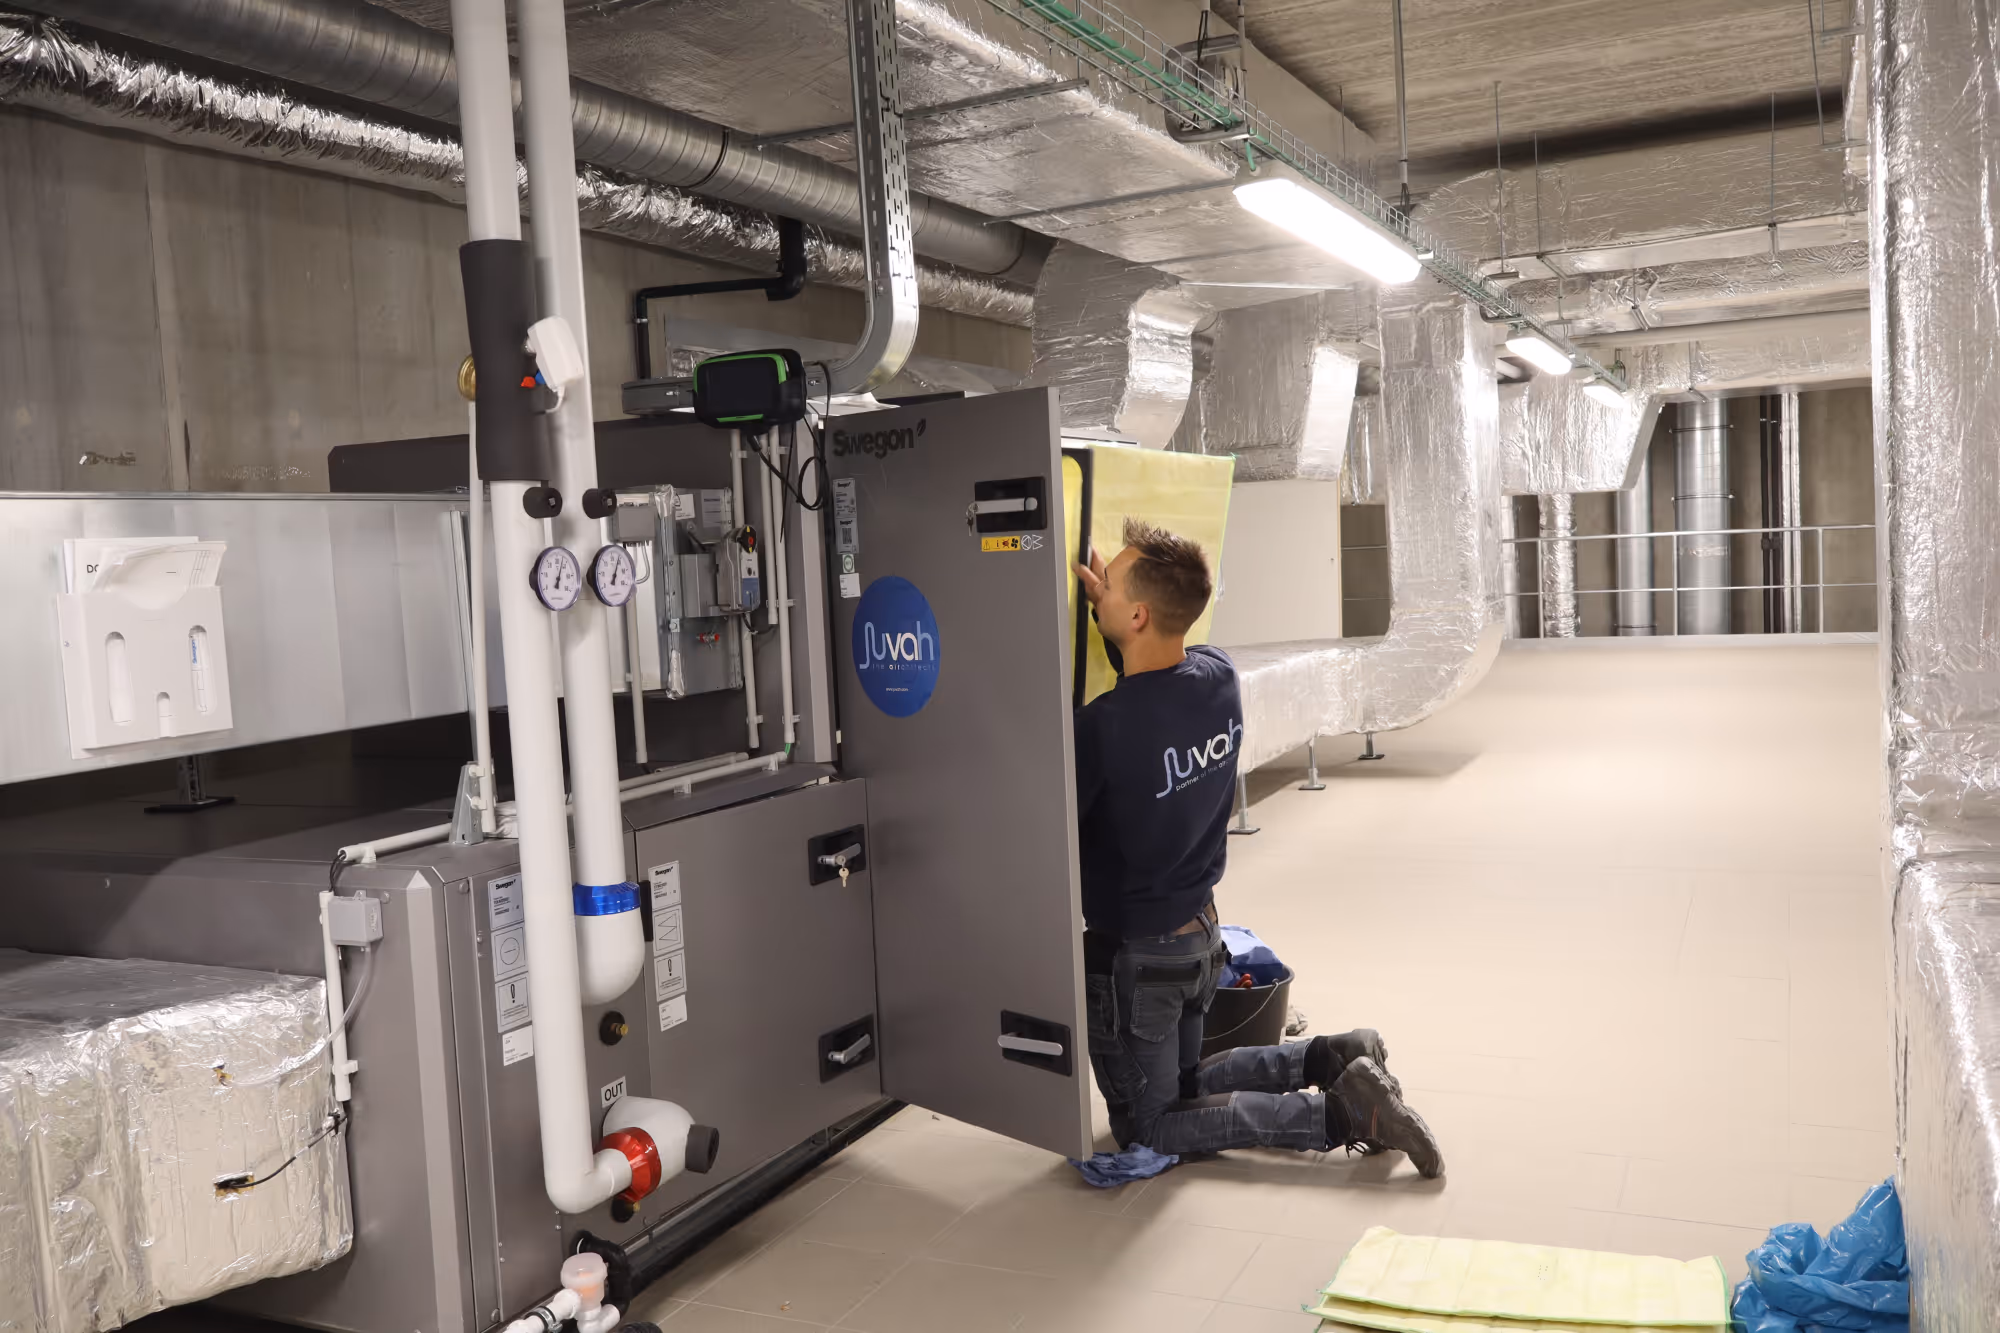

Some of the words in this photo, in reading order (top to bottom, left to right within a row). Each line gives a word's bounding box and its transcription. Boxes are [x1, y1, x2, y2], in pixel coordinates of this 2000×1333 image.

[833, 428, 914, 459] Swegon
[1175, 775, 1200, 791] partner
[495, 880, 514, 890] Swegon
[604, 1081, 623, 1101] OUT
